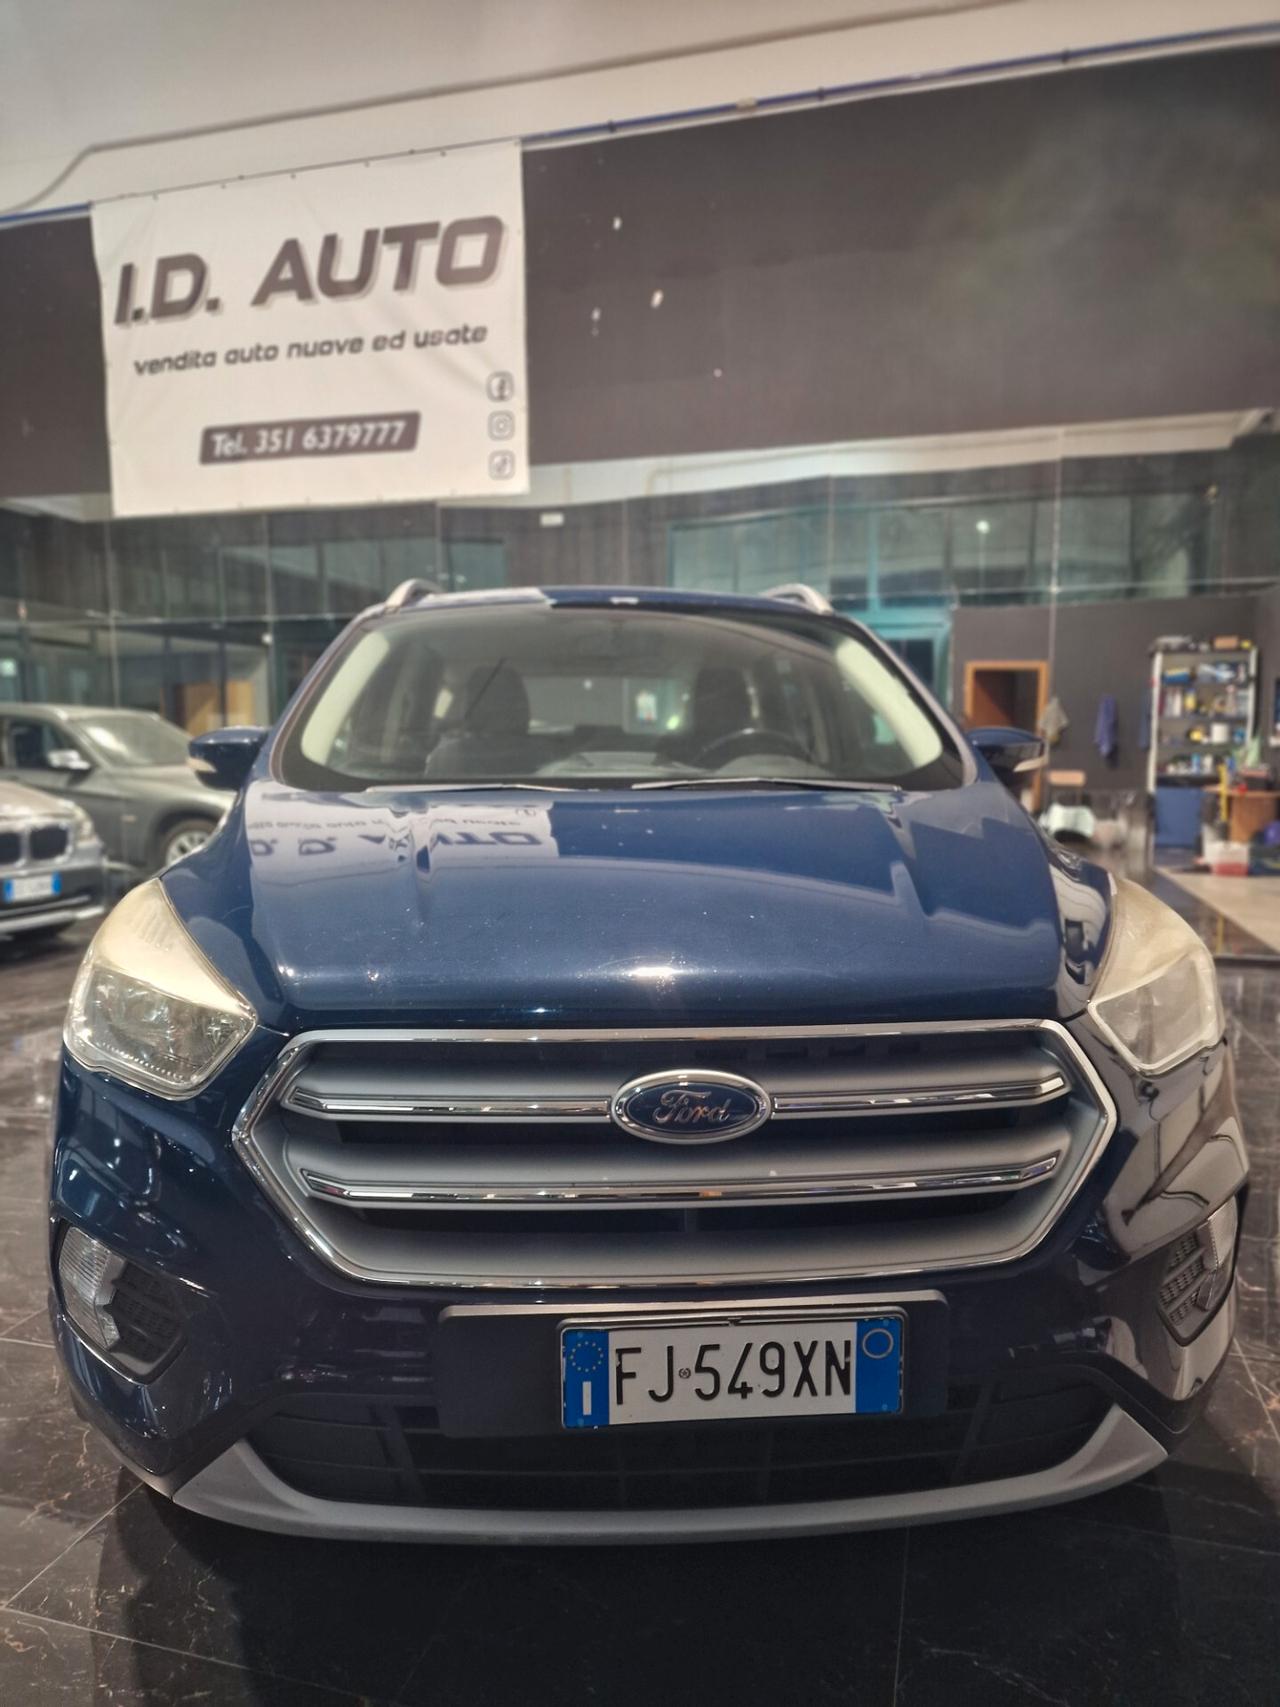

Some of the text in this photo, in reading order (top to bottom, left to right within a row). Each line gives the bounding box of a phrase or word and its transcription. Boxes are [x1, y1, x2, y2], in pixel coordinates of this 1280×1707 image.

[113, 215, 507, 326] I.D. AUTO
[134, 323, 488, 375] vendita auto nuove ed usate
[211, 420, 406, 457] Tel. 351 6379777
[653, 1089, 730, 1124] Ford
